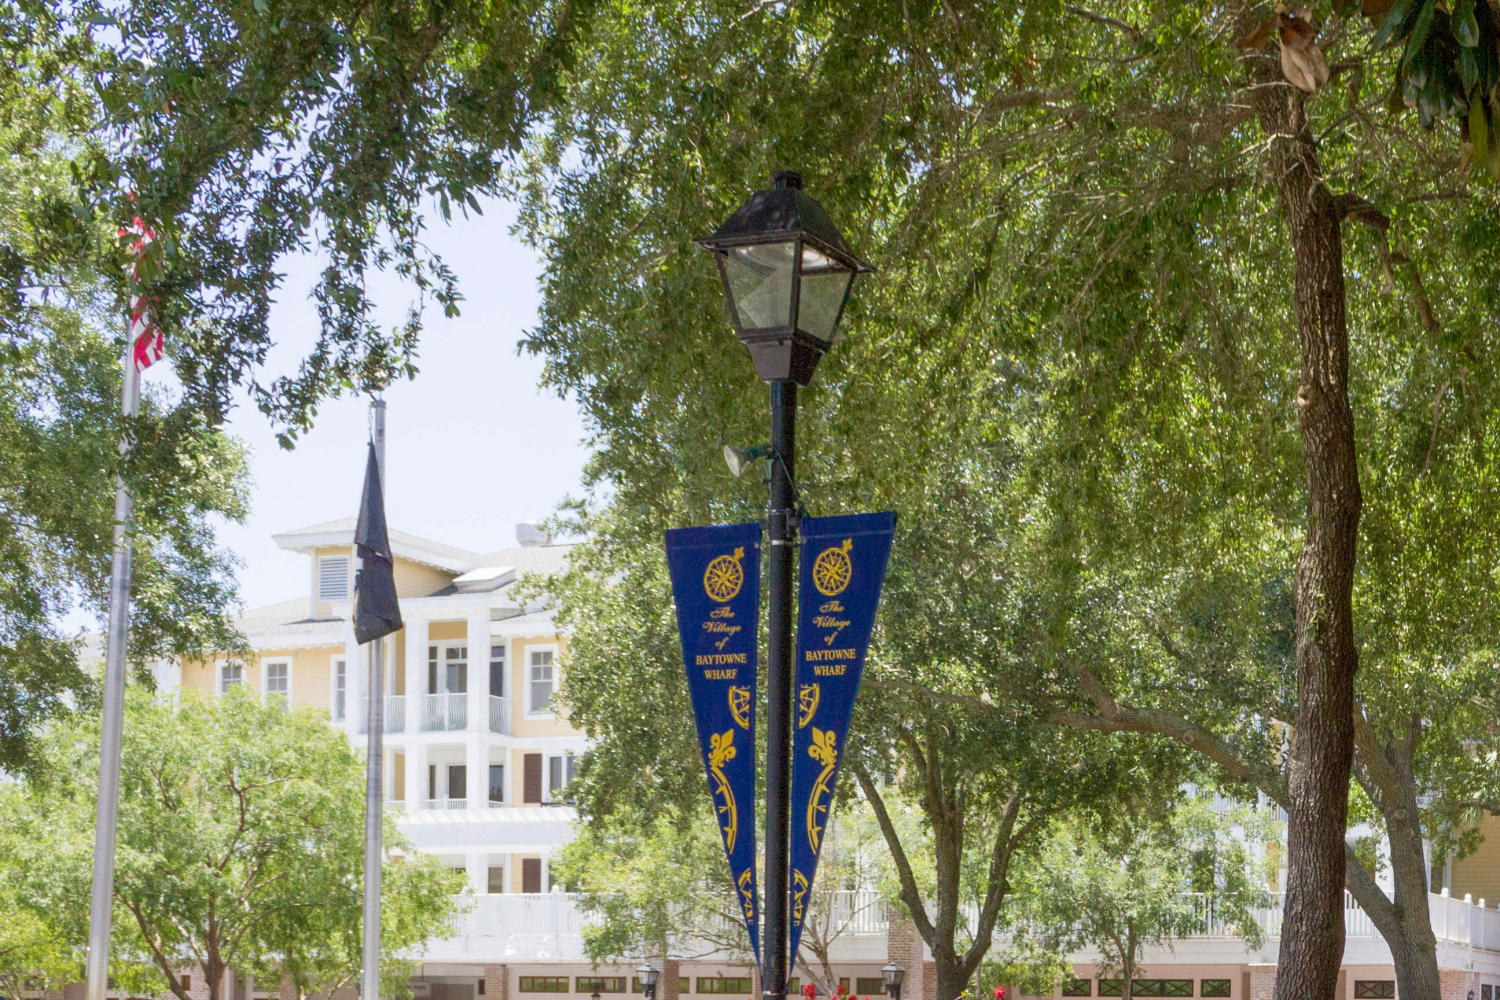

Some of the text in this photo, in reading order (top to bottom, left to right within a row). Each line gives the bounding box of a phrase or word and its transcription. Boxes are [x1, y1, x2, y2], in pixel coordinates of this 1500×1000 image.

[710, 606, 736, 618] The
[819, 600, 845, 613] The
[702, 621, 741, 636] Village
[812, 615, 851, 631] Village
[715, 636, 729, 650] of
[824, 631, 839, 646] of
[696, 653, 747, 666] BAYTOWNE
[805, 648, 856, 661] BAYTOWNE
[704, 669, 738, 680] WHARF
[813, 664, 847, 676] WHARF
